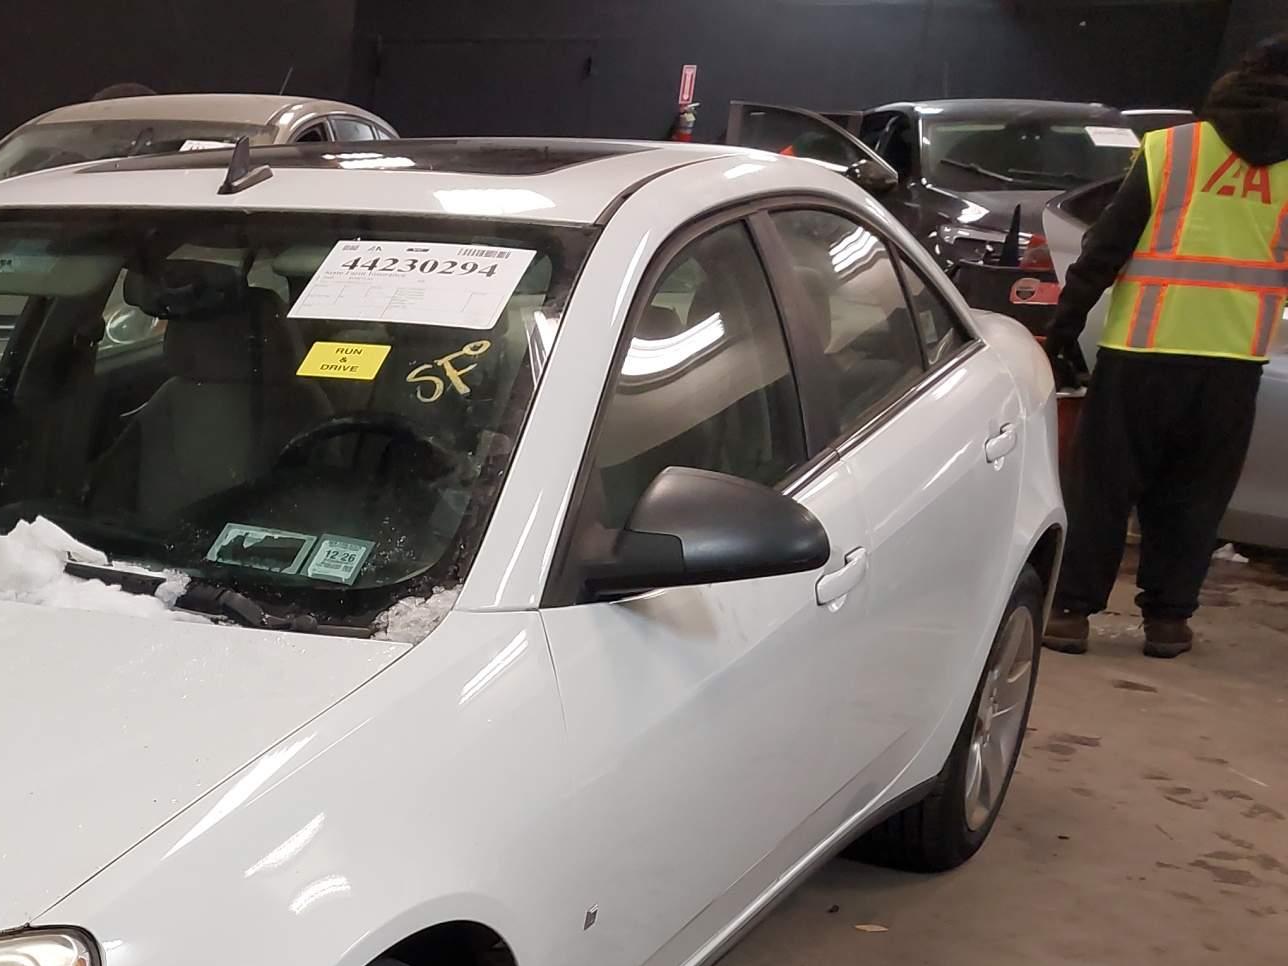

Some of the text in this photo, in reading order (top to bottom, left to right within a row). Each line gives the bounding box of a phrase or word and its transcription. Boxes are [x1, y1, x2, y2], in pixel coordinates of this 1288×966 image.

[341, 256, 499, 277] 44230294
[335, 347, 363, 355] RUN
[319, 363, 360, 372] DRIVE
[325, 550, 357, 563] 12 26
